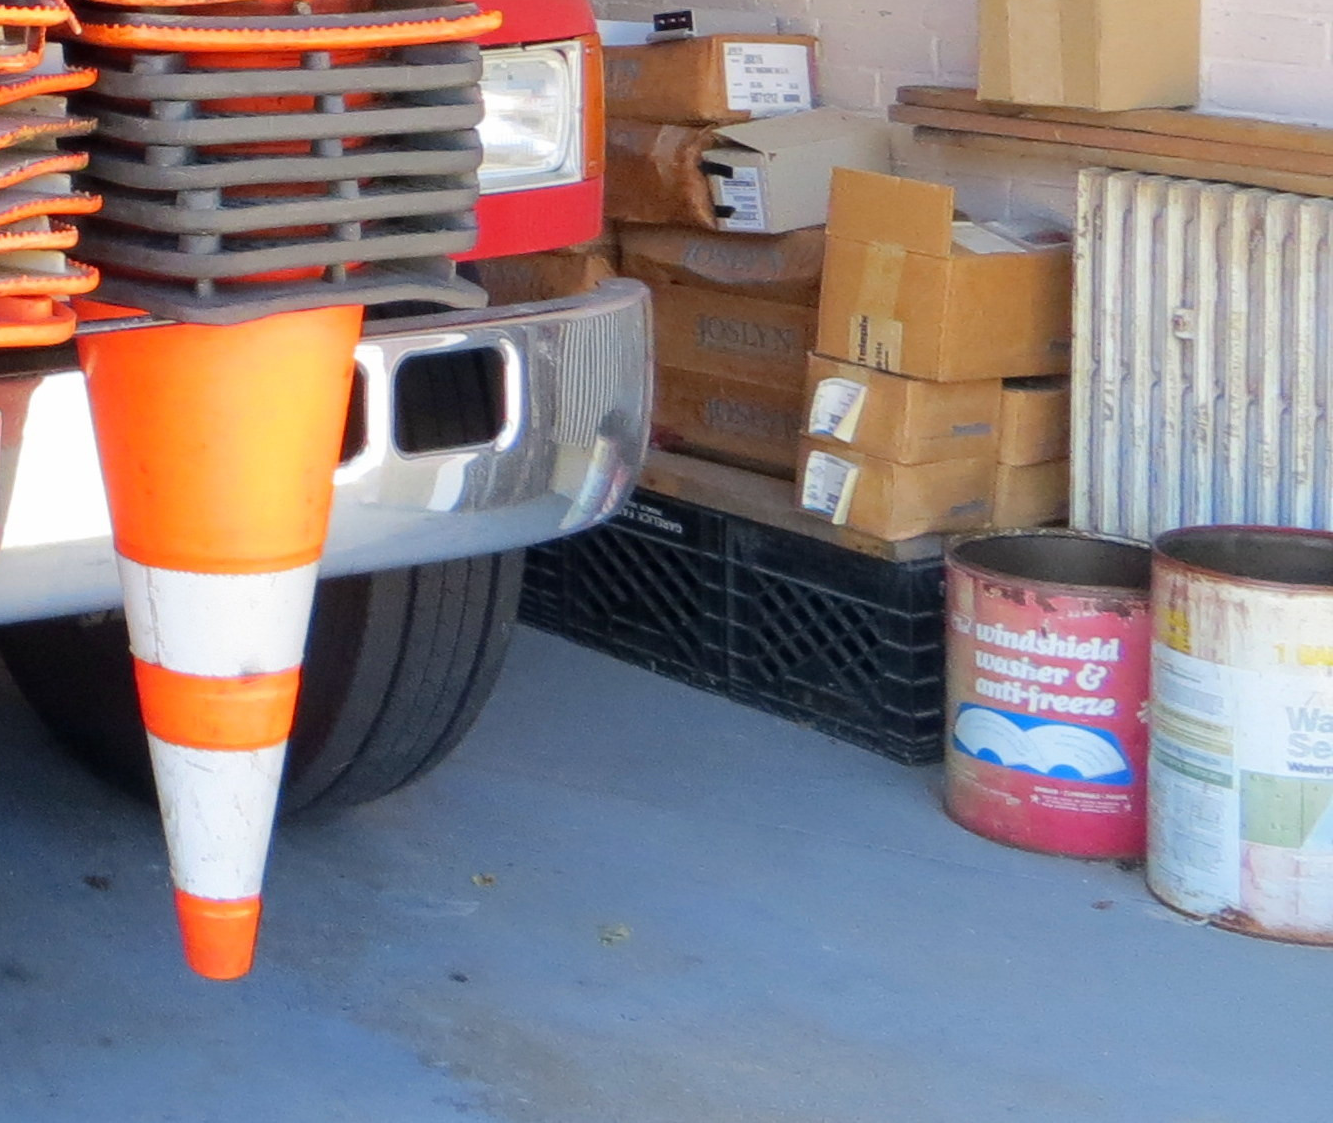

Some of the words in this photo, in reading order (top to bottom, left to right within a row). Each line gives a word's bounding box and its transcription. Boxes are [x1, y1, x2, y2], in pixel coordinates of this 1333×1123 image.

[976, 622, 1121, 663] windshield
[975, 651, 1070, 687] washer
[1076, 662, 1108, 692] &
[975, 677, 1117, 717] anti-freeze
